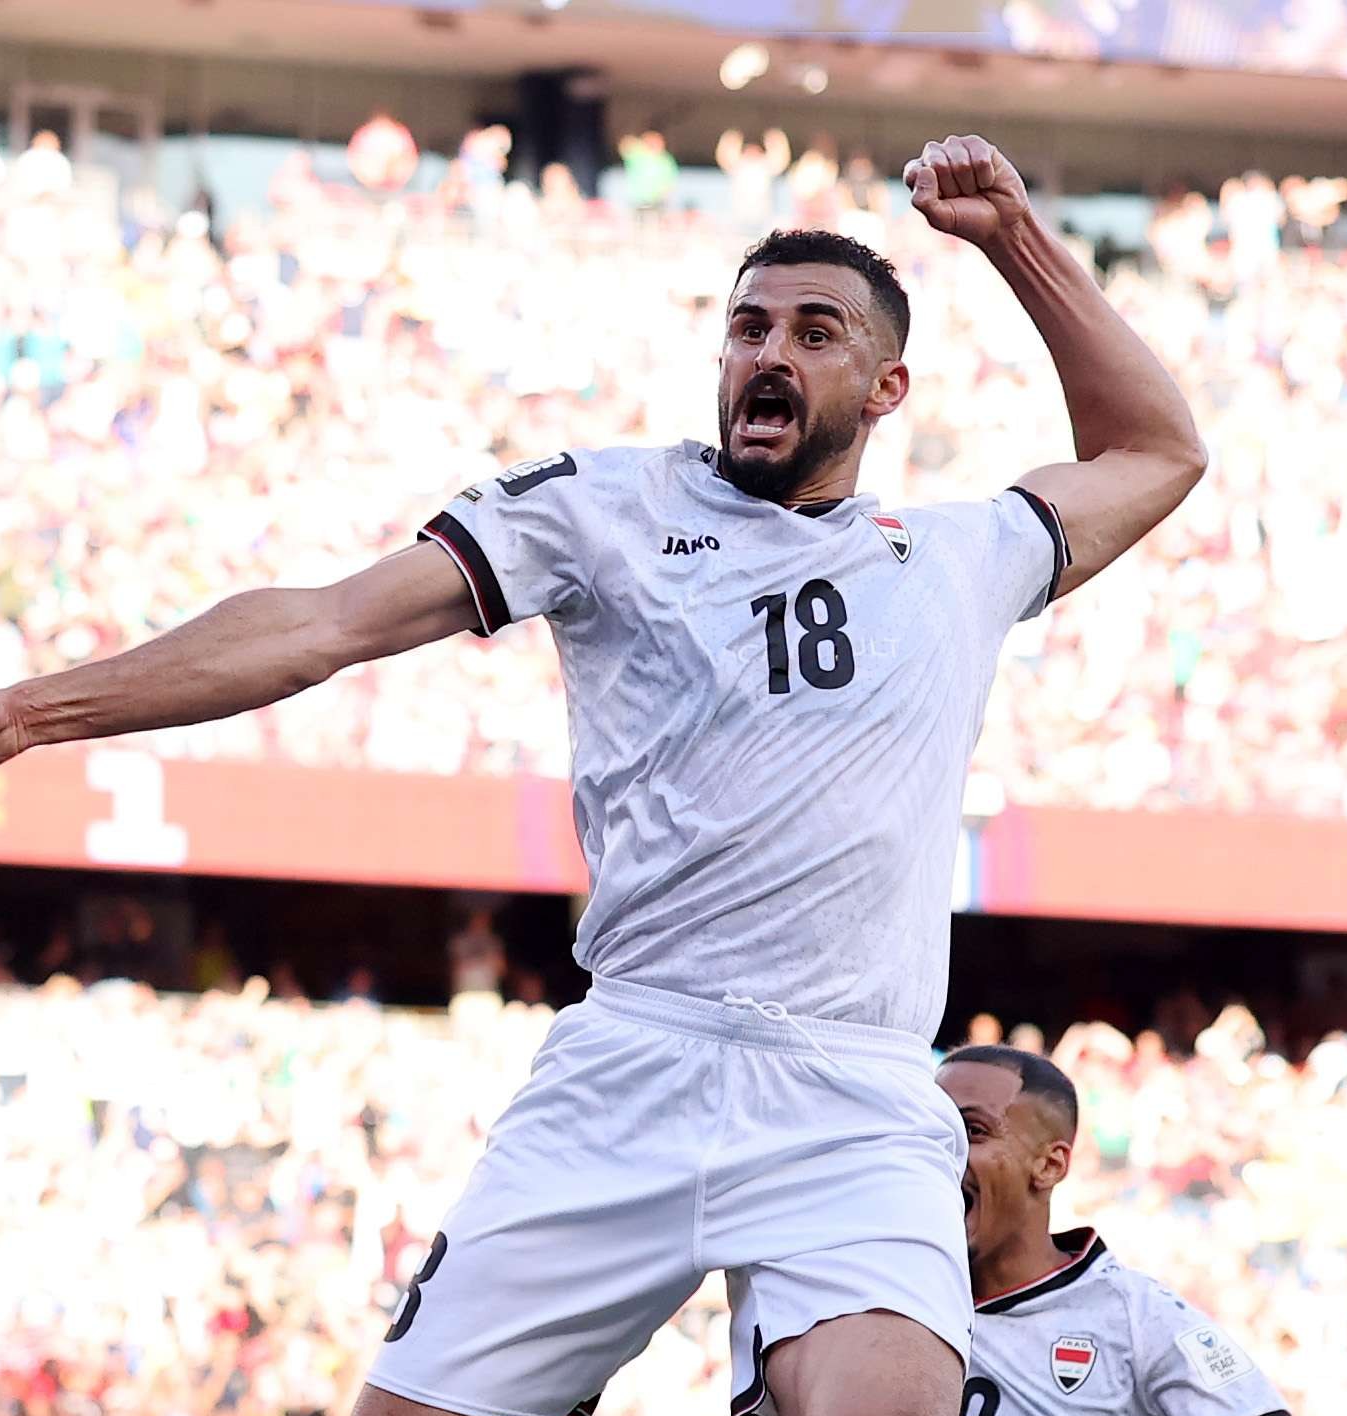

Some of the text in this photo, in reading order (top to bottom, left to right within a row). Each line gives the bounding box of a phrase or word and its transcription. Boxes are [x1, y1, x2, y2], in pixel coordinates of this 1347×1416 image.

[662, 535, 720, 555] JAKO
[750, 578, 855, 694] 18
[86, 749, 188, 866] 1
